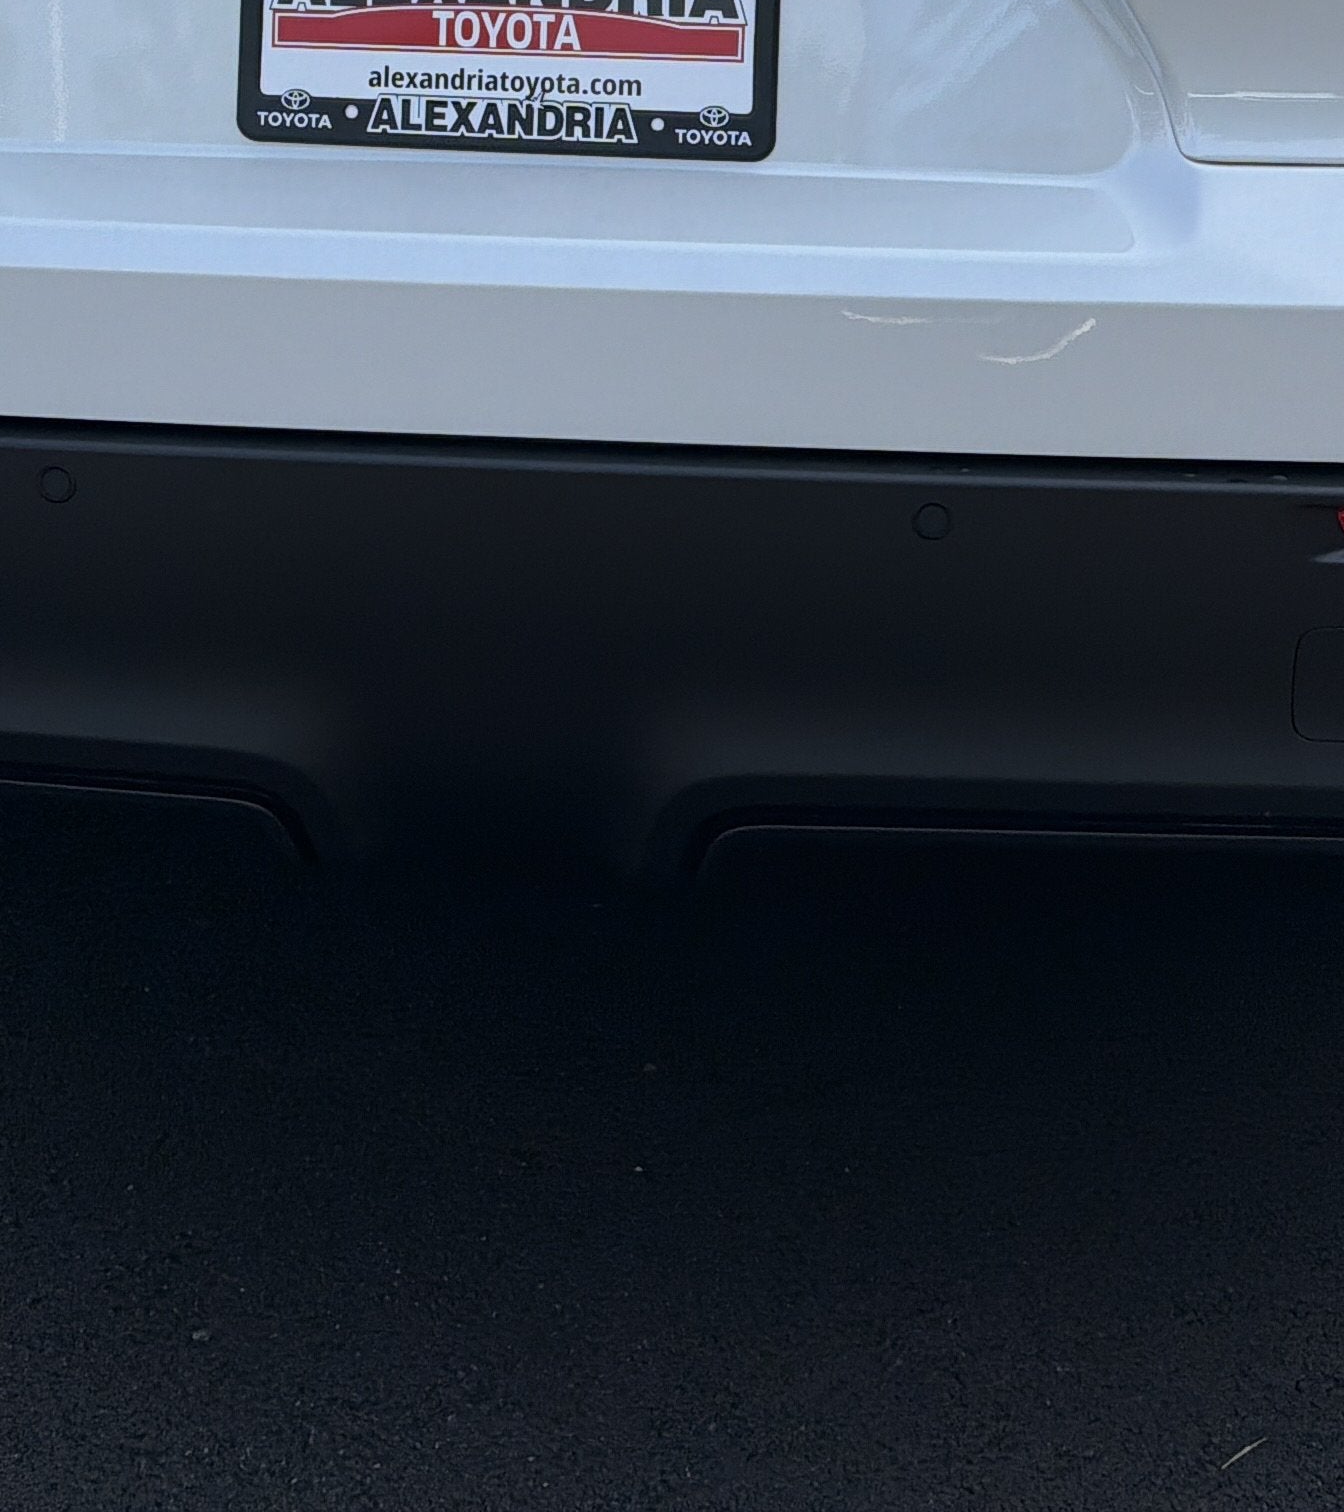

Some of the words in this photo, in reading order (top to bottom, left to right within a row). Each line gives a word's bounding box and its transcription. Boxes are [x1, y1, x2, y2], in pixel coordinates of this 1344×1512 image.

[432, 9, 582, 52] TOYOTA
[368, 65, 643, 97] alexandriatoyota.com
[257, 111, 332, 131] TOYOTA
[367, 94, 638, 144] ALEXANDRIA
[674, 128, 752, 147] TOYOTA
